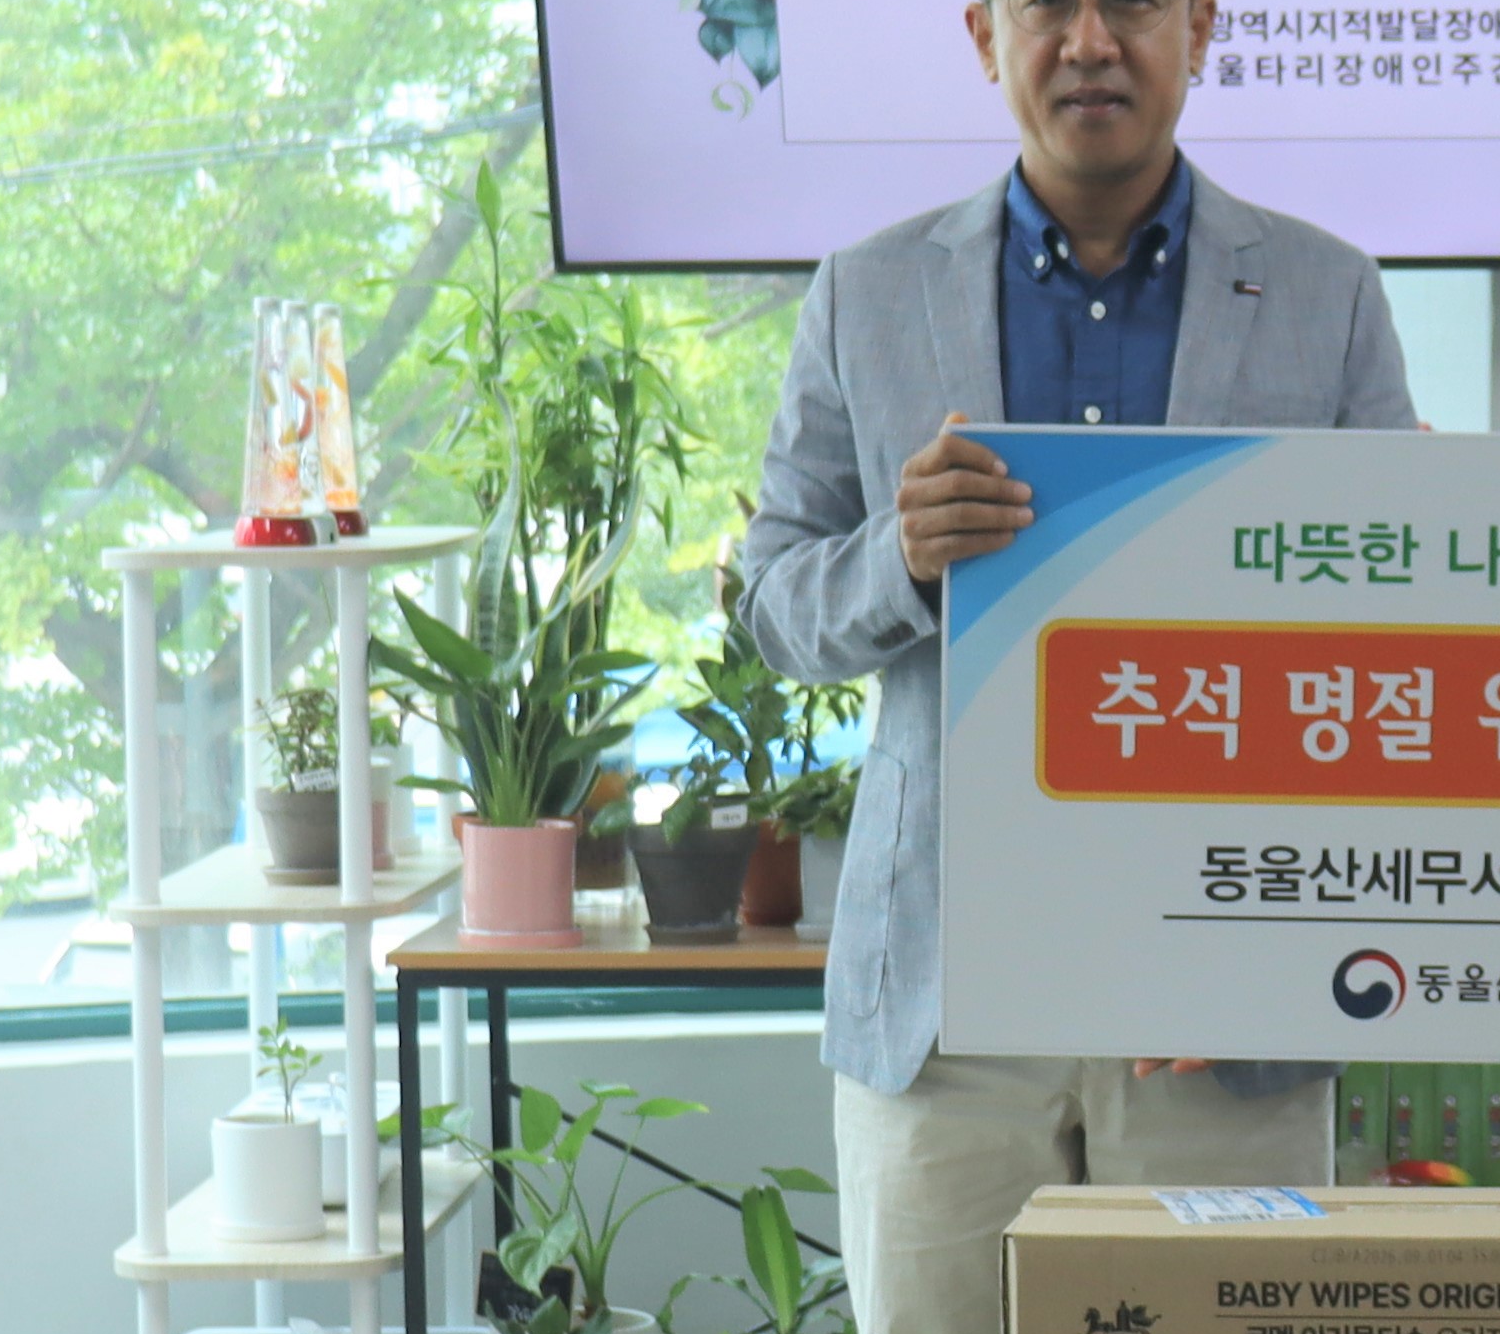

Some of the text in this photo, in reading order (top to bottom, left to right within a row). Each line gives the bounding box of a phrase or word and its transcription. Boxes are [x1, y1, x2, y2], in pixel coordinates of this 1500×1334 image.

[1232, 521, 1420, 586] 따뜻한
[1091, 660, 1243, 762] 추석
[1285, 664, 1436, 764] 명절
[1217, 1281, 1302, 1309] BABY
[1311, 1282, 1410, 1310] WIPES
